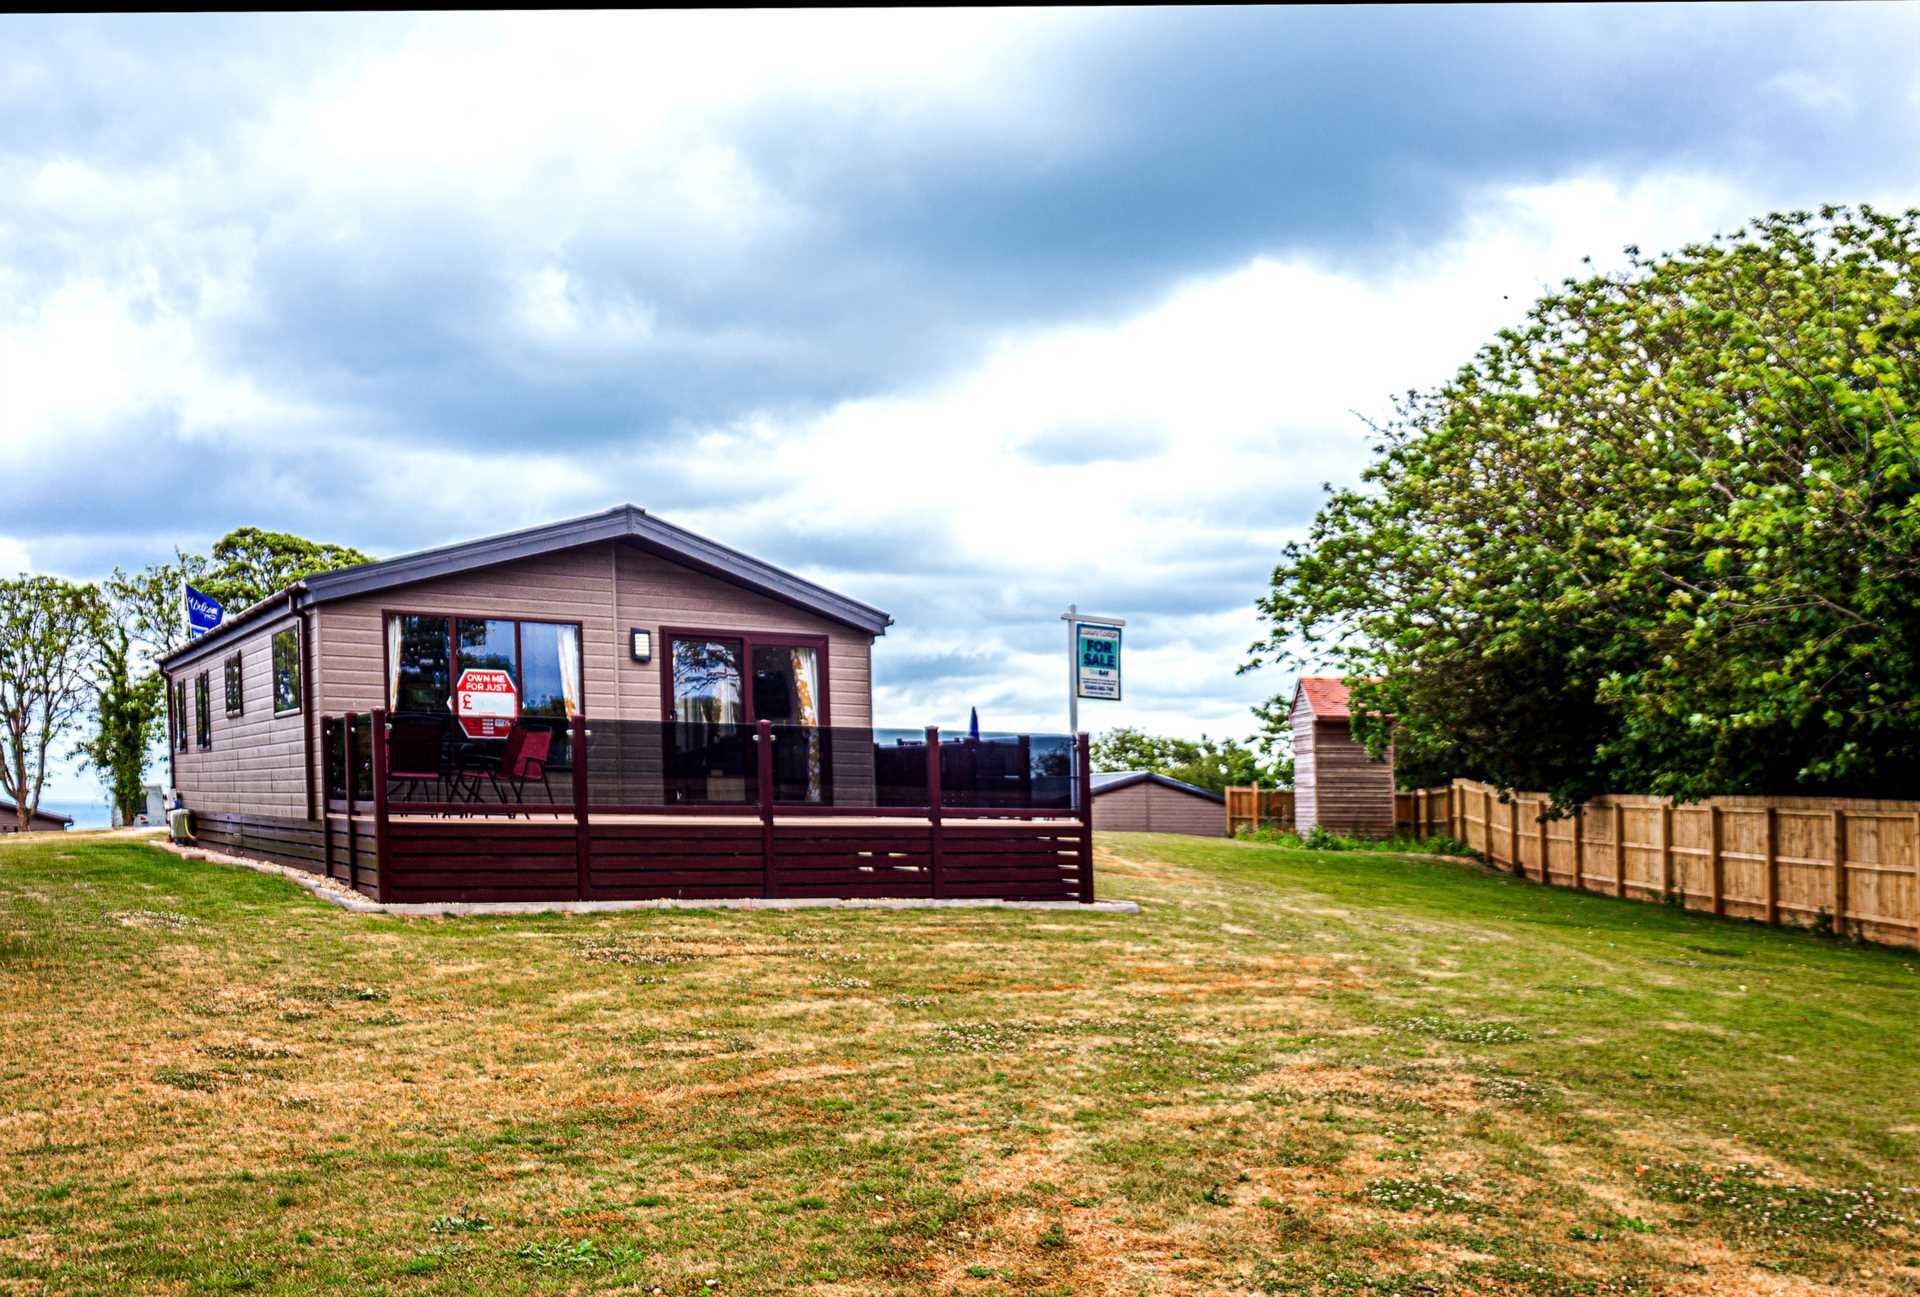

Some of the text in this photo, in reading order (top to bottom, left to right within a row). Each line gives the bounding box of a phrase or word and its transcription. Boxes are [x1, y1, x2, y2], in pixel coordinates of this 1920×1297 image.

[1087, 640, 1112, 653] FOR
[1084, 653, 1114, 666] SALE
[466, 674, 506, 683] OWN ME
[466, 682, 508, 692] FOR JUST
